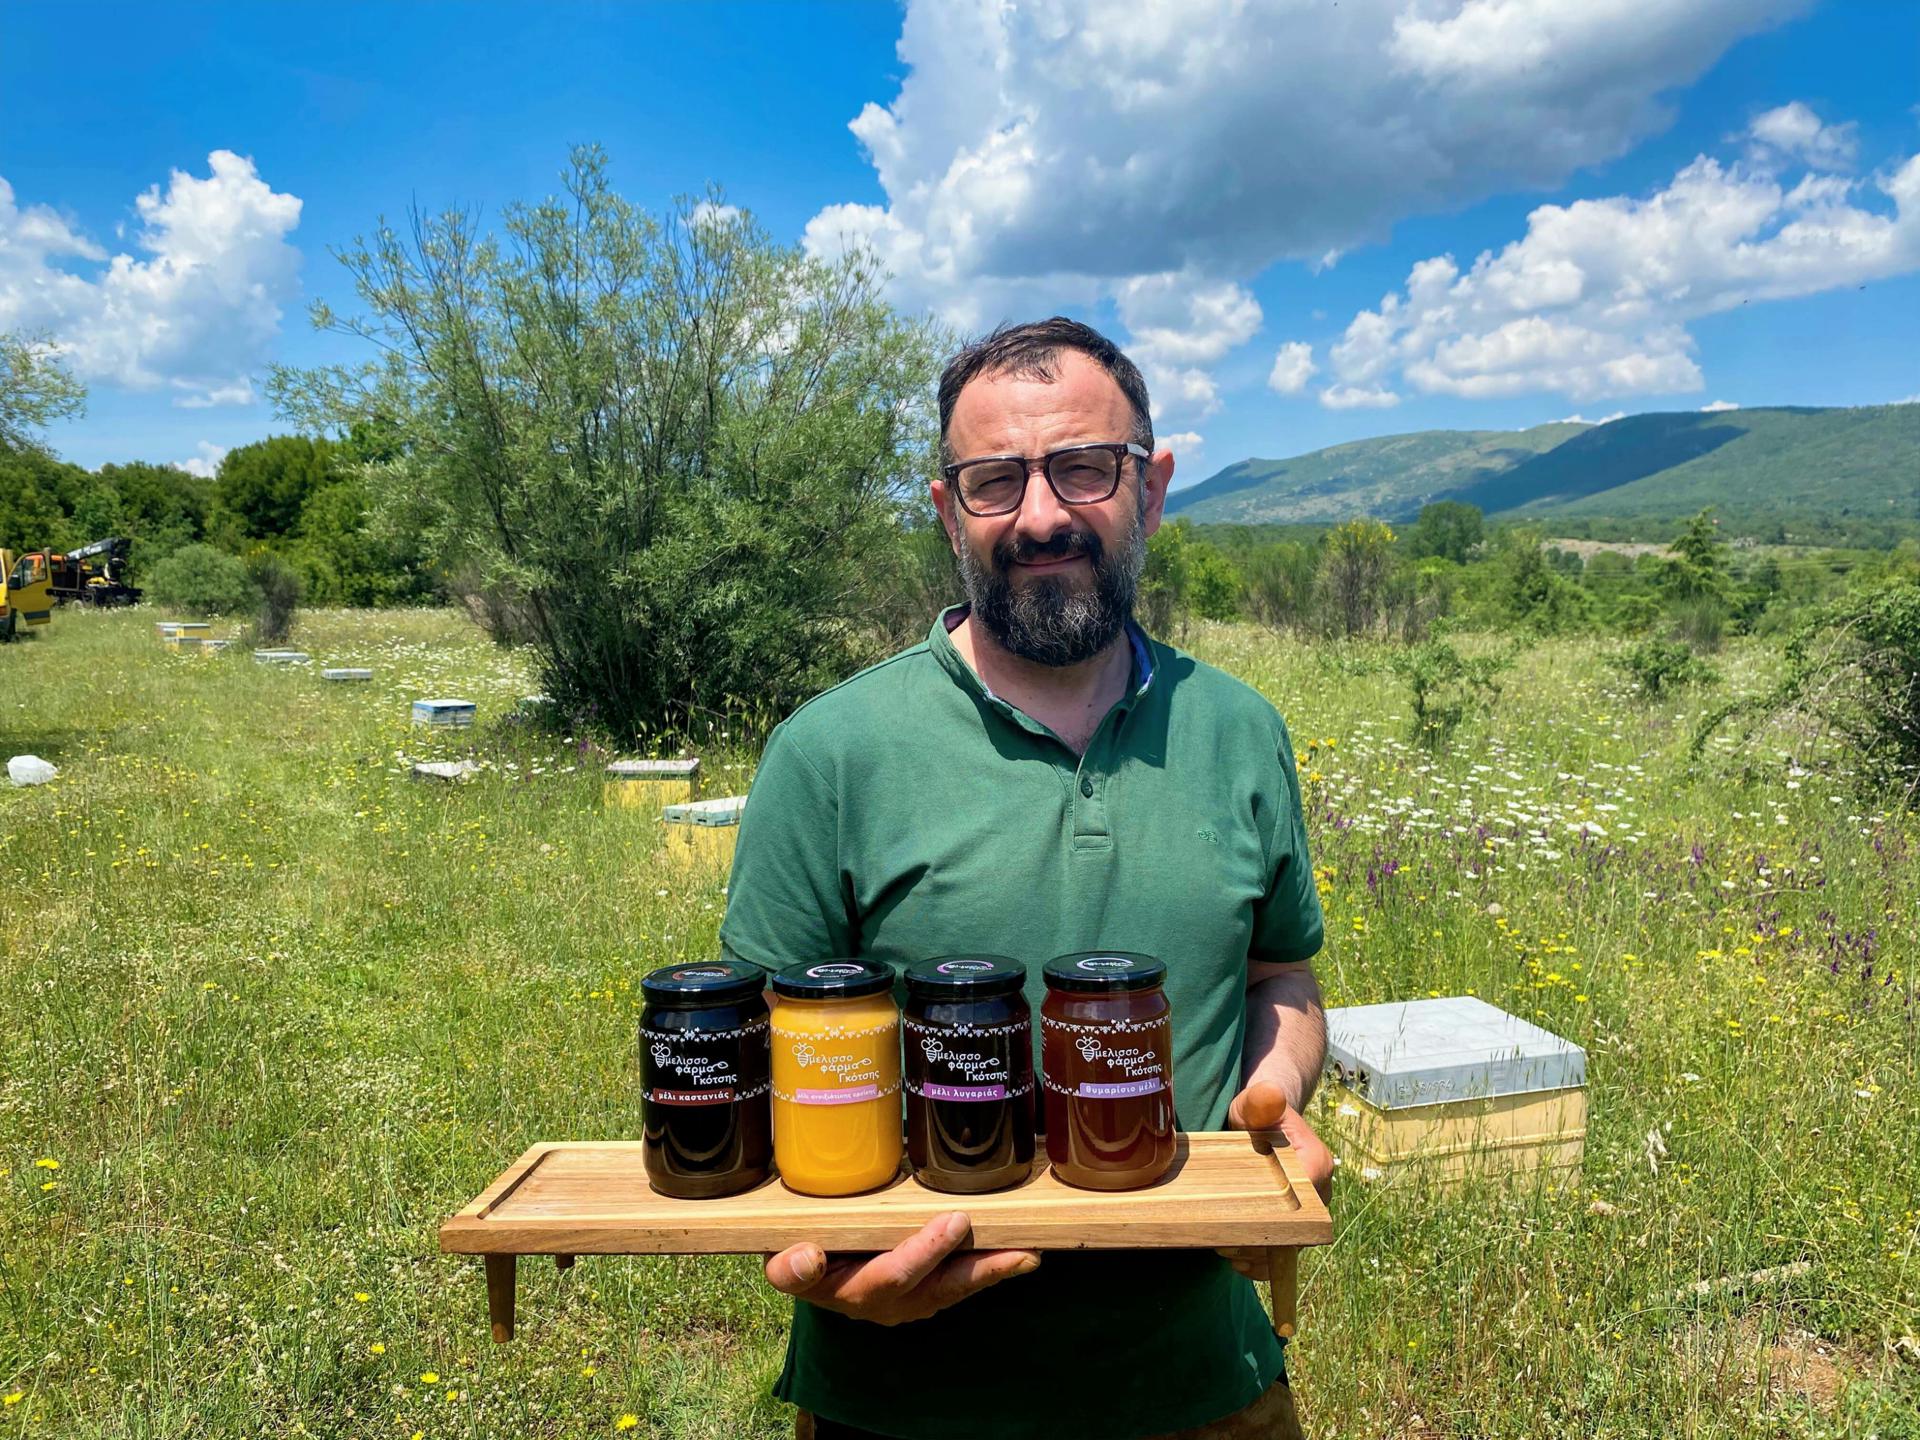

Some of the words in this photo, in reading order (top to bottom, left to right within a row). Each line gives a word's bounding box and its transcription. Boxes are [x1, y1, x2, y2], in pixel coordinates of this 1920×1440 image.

[937, 1051, 981, 1061] μελισσο
[1094, 1048, 1139, 1059] μελισσο
[665, 1056, 709, 1066] μελισσο
[947, 1060, 987, 1071] φάρμα
[1107, 1057, 1145, 1068] φάρμα
[675, 1064, 715, 1076] φάρμα
[1125, 1064, 1162, 1077] Γκότσης
[693, 1074, 737, 1085] Γκότσης
[839, 1070, 880, 1083] Γκότσης
[966, 1071, 1008, 1081] Γκότσης
[931, 1088, 950, 1096] μέλι
[953, 1088, 998, 1098] λυγαριάς
[1085, 1085, 1136, 1095] θυμαρίσιο
[1138, 1081, 1156, 1092] μέλι
[658, 1092, 676, 1101] μέλι
[679, 1091, 729, 1101] καστανιάς
